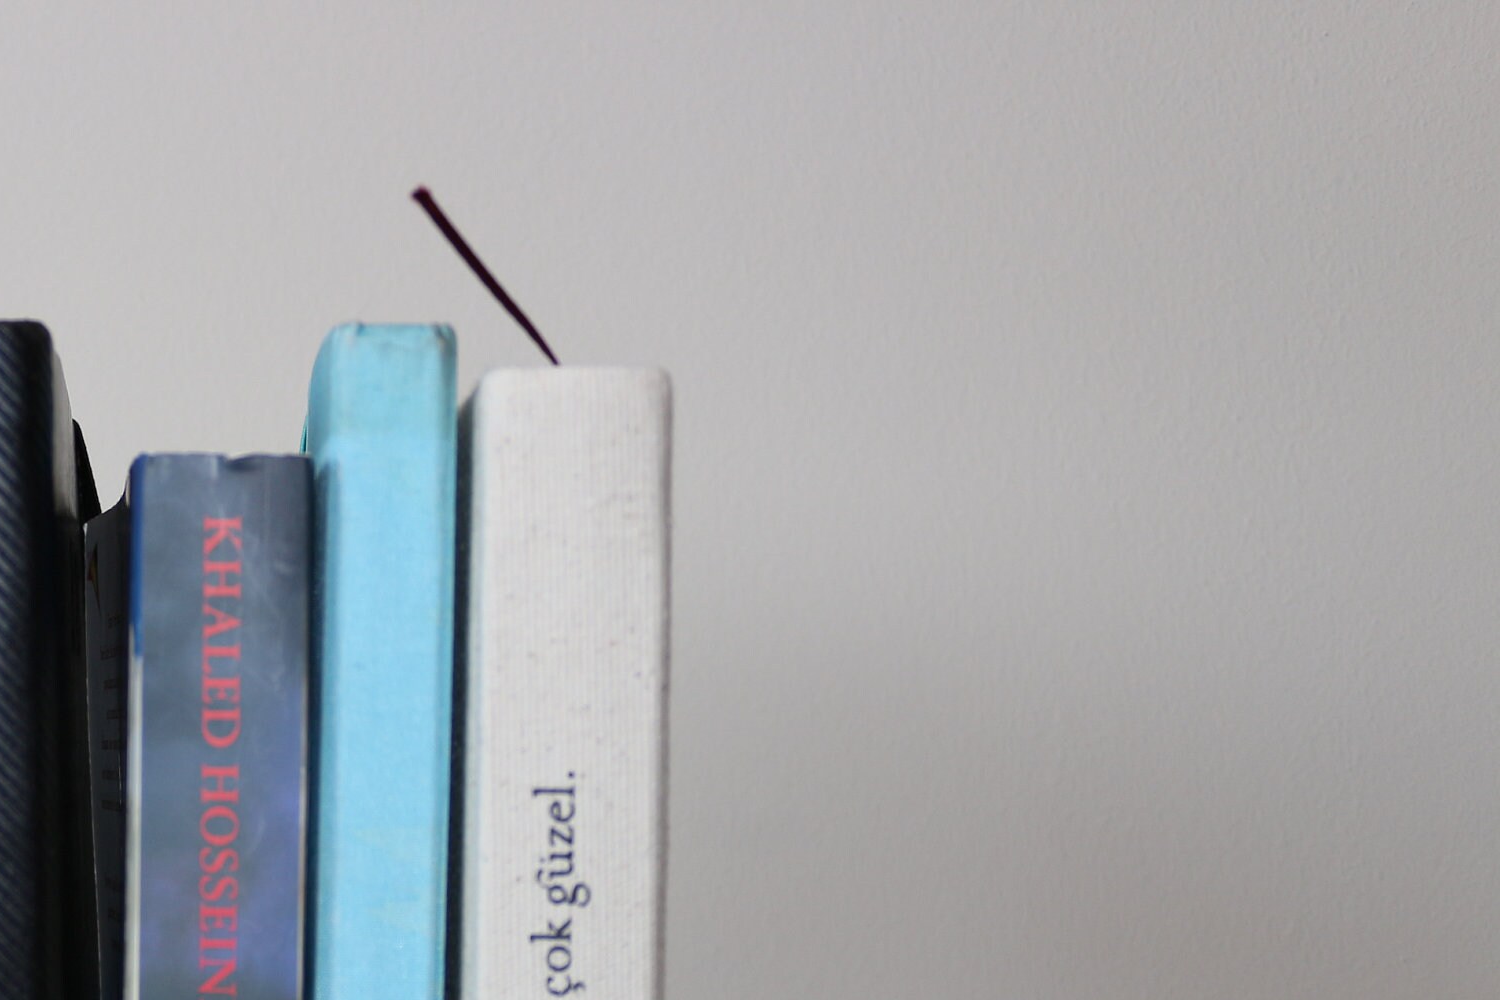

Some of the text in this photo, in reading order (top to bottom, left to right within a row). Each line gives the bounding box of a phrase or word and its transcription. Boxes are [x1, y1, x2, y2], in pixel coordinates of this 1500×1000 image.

[202, 516, 243, 749] KHALED
[531, 770, 592, 907] güzel.
[529, 918, 585, 996] çok
